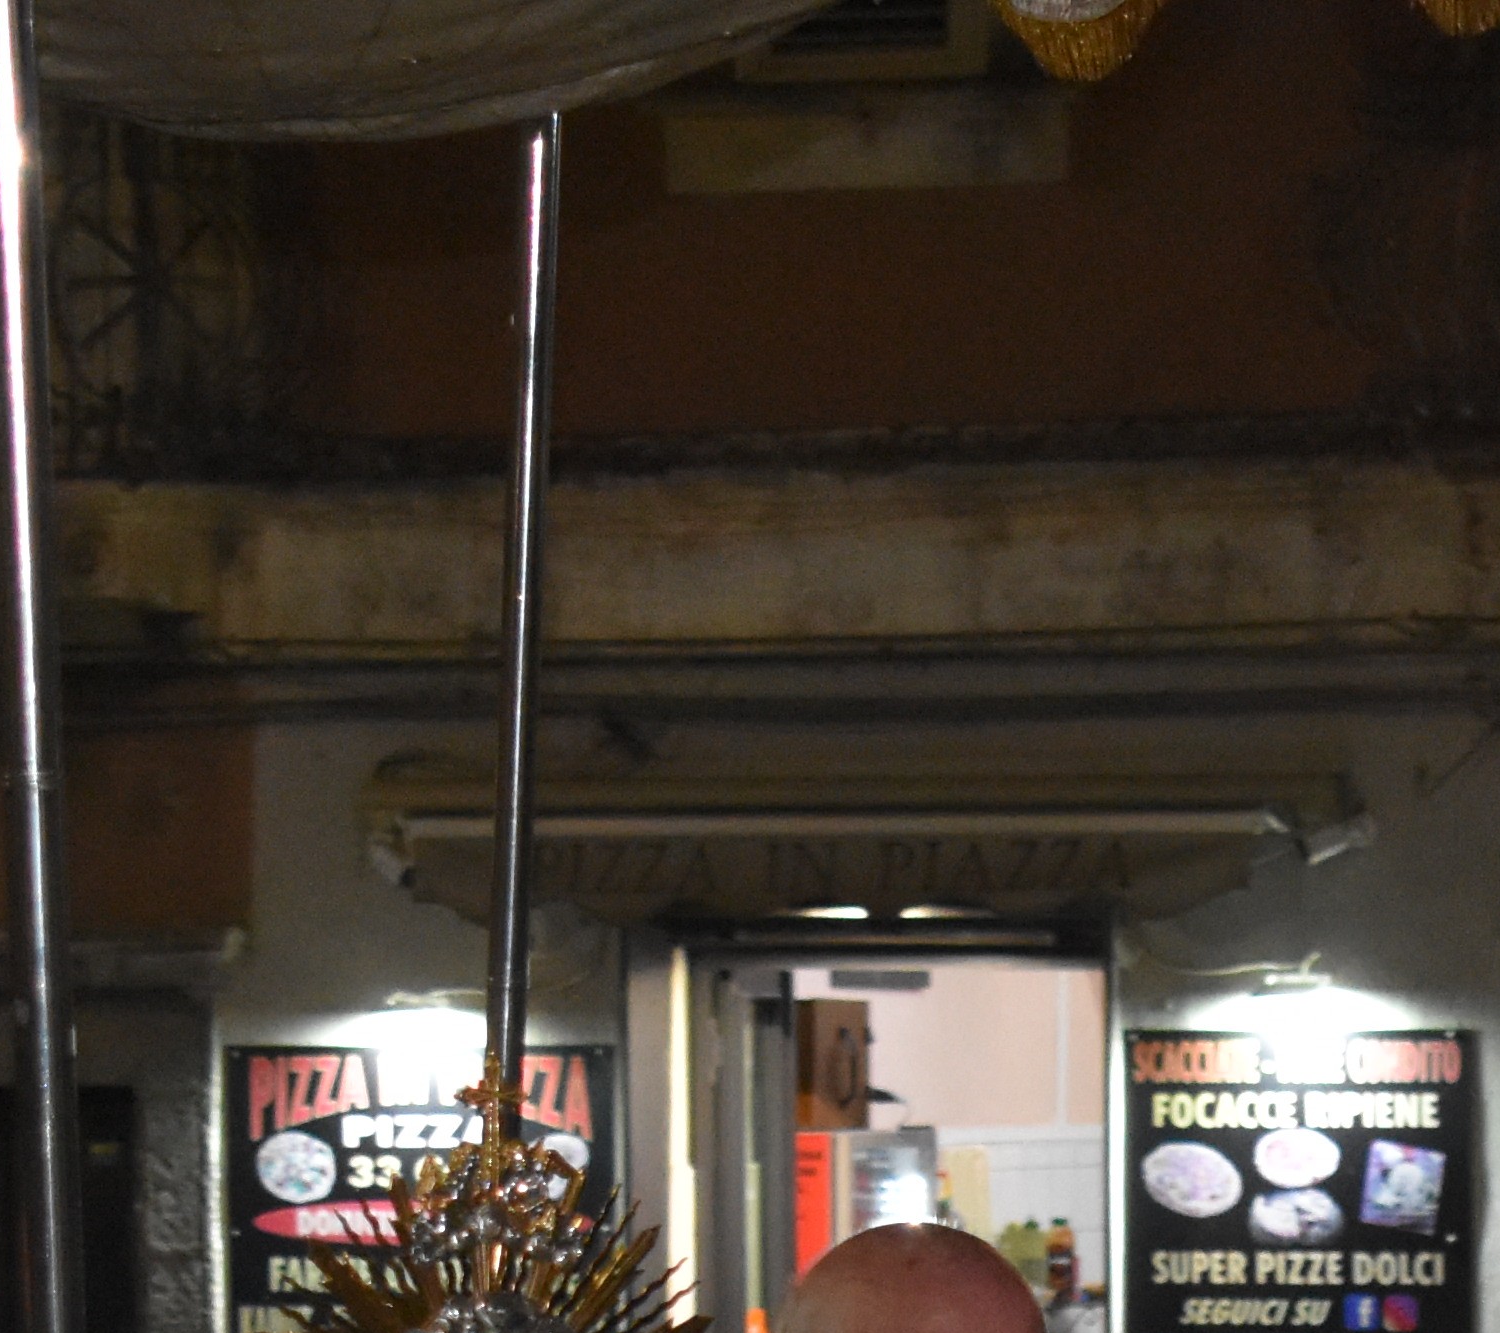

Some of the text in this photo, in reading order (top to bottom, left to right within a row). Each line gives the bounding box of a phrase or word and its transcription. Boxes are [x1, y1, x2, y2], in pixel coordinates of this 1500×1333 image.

[531, 839, 1134, 894] PIZZA IN PIAZZA
[248, 1053, 370, 1142] PIZZA
[1152, 1090, 1299, 1130] FOCACCE
[1150, 1250, 1447, 1286] SUPER PIZZE DOLCI
[1180, 1297, 1333, 1326] SEGUICI SU
